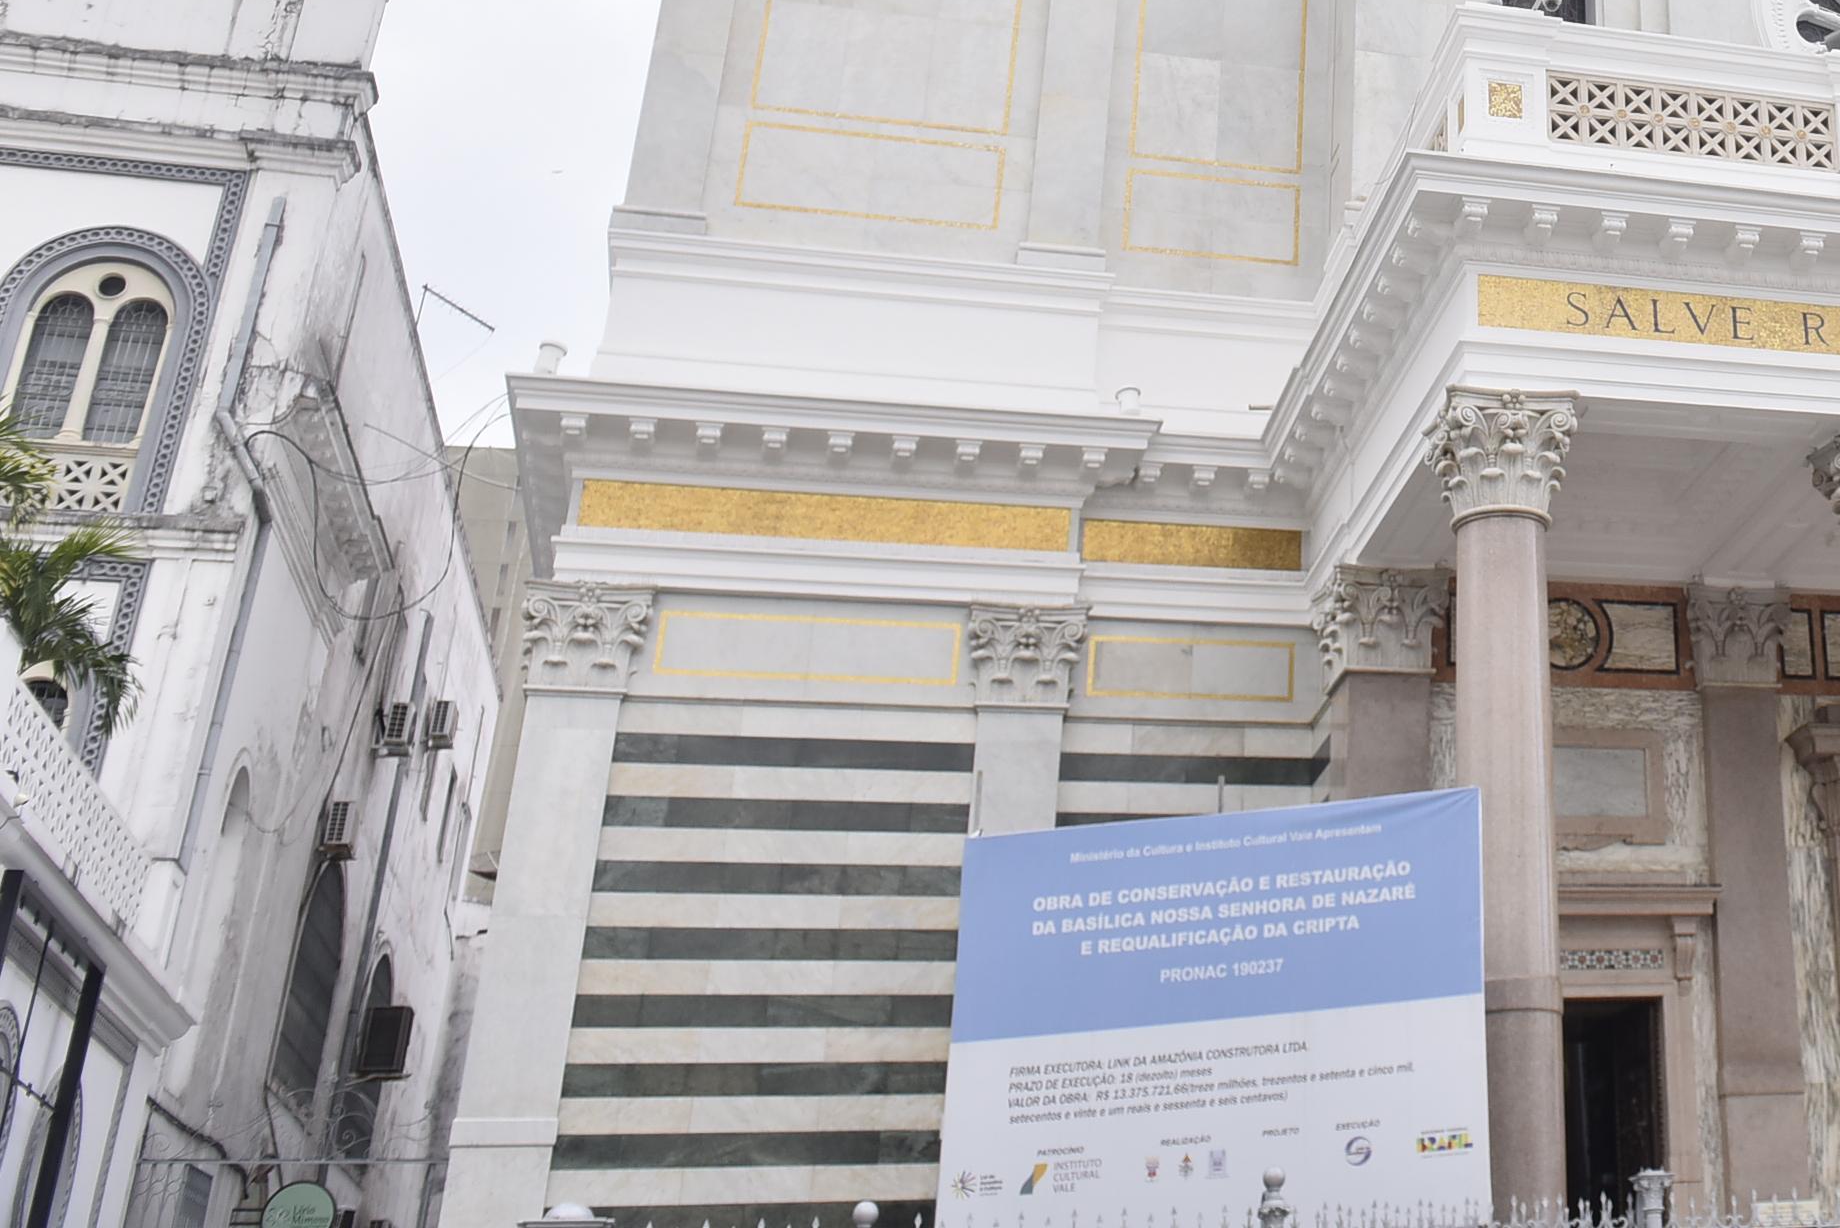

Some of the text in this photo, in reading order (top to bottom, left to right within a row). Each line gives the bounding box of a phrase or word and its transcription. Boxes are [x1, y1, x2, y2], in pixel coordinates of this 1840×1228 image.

[1566, 292, 1755, 340] SALVE
[1069, 822, 1381, 863] Ministério da Cultura e Instituto Cultural Vale Apresentam
[1032, 859, 1411, 912] OBRA DE CONSERVAÇÃO E RESTAURAÇÃO
[1032, 881, 1416, 937] DA BASÍLICA NOSSA SENHORA DE NAZARÉ
[1080, 915, 1360, 955] E REQUALIFICAÇÃO DA CRIPTA
[1159, 958, 1283, 984] PRONAC 190237
[1009, 1065, 1040, 1078] FIRMA
[1043, 1059, 1103, 1075] EXECUTORA:
[1107, 1056, 1130, 1069] LINK
[1133, 1055, 1147, 1066] DA
[1149, 1047, 1203, 1066] AMAZÔNIA
[1206, 1043, 1279, 1061] CONSTRUTORA
[1007, 1096, 1040, 1109] VALOR
[1042, 1095, 1056, 1106] DA
[1095, 1089, 1109, 1101] R$
[1262, 1072, 1307, 1086] trezentos
[1319, 1068, 1356, 1080] setenta
[1368, 1064, 1394, 1076] cinco
[1008, 1066, 1212, 1094] PRAZO DE EXECUÇÃO: 18 (dezoito) meses
[1009, 1111, 1062, 1125] setecentos
[1073, 1107, 1097, 1119] vinte
[1108, 1107, 1124, 1115] um
[1126, 1102, 1150, 1114] reais
[1163, 1097, 1206, 1110] sessenta
[1217, 1094, 1237, 1105] seis
[1239, 1090, 1288, 1105] centavos)
[1052, 1157, 1102, 1171] INSTITUTO
[1052, 1169, 1099, 1182] CULTURAL
[1051, 1182, 1075, 1193] VALE
